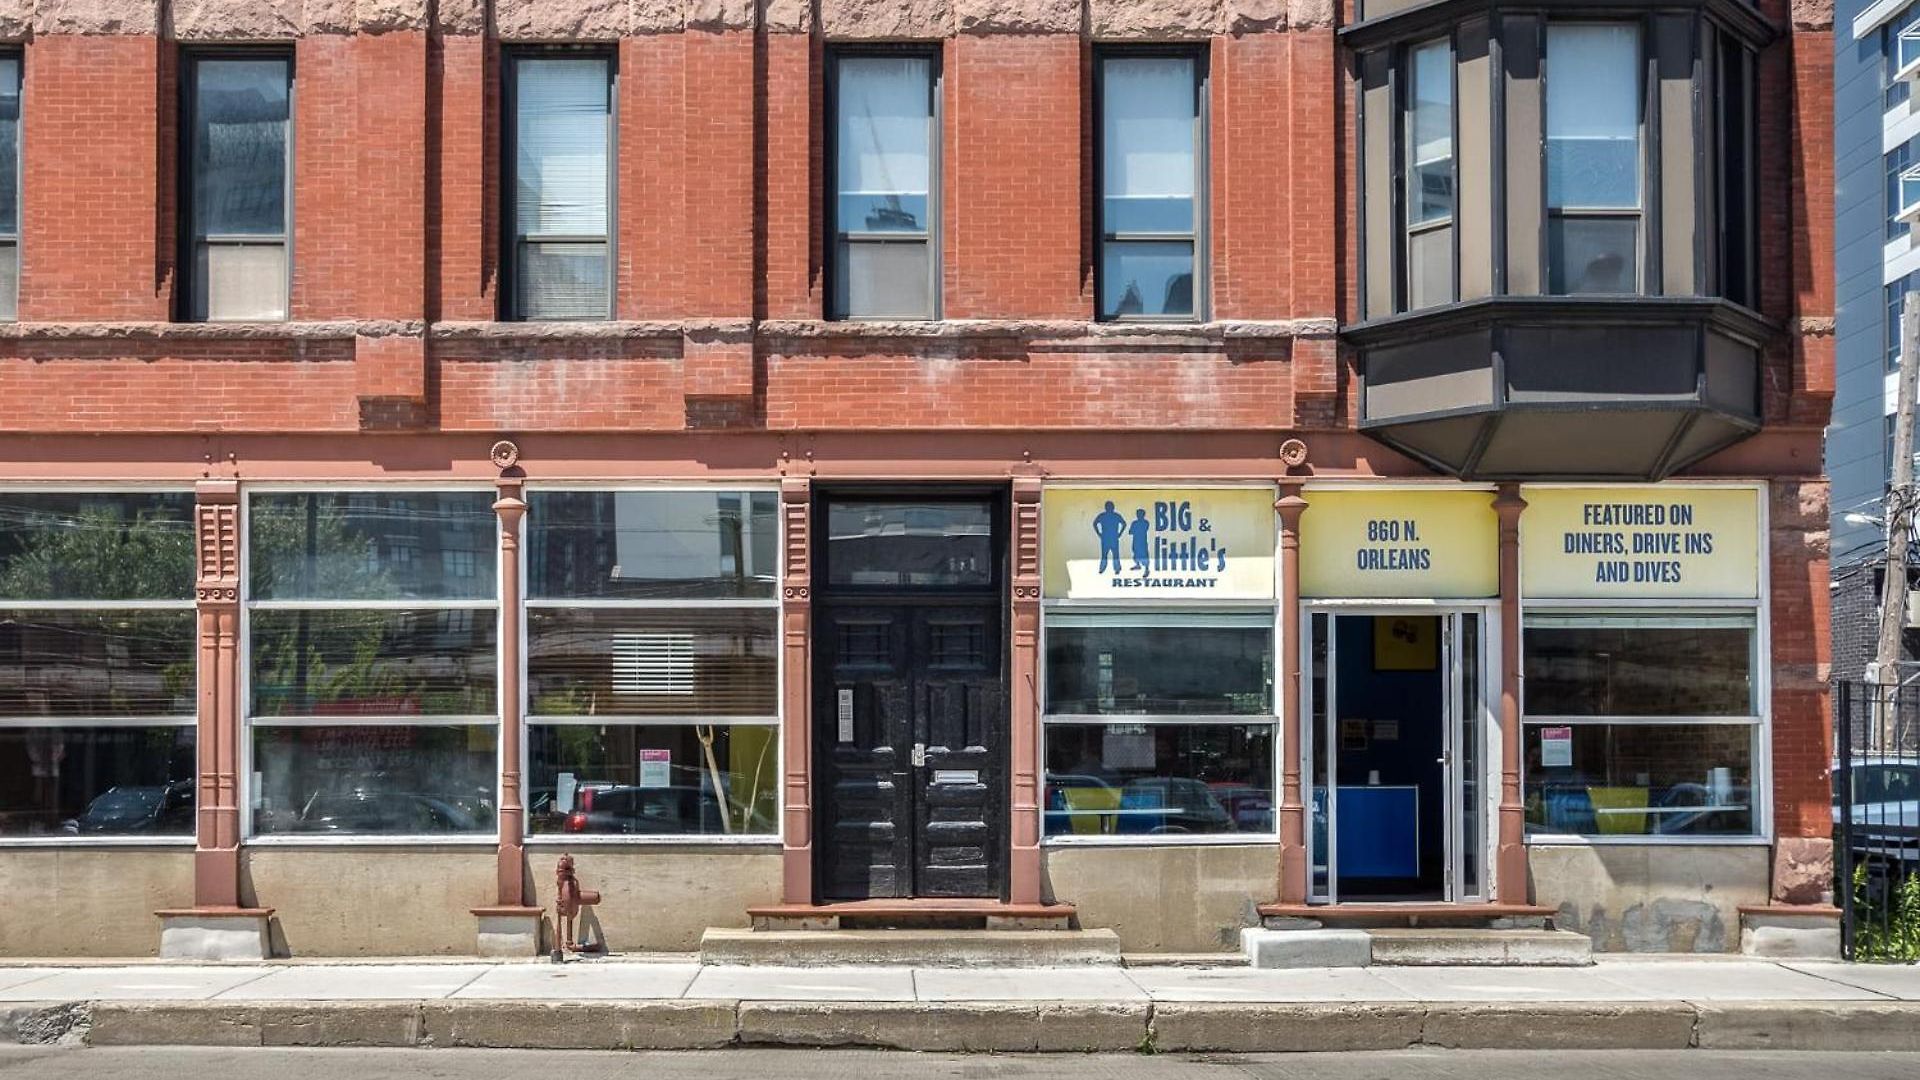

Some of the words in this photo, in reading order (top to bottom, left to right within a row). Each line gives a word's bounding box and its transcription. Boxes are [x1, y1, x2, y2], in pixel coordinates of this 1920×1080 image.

[1154, 501, 1192, 532] BIG
[1199, 517, 1212, 532] &
[1584, 504, 1665, 525] FEATURED
[1670, 504, 1692, 525] ON
[1368, 520, 1399, 541] 860
[1404, 520, 1419, 541] N.
[1154, 536, 1226, 573] little's
[1564, 533, 1628, 555] DINERS,
[1632, 533, 1680, 553] DRIVE
[1685, 533, 1713, 554] INS
[1357, 548, 1430, 569] ORLEANS
[1112, 577, 1218, 588] RESTAURANT
[1596, 561, 1629, 583] AND
[1634, 561, 1681, 583] DIVES
